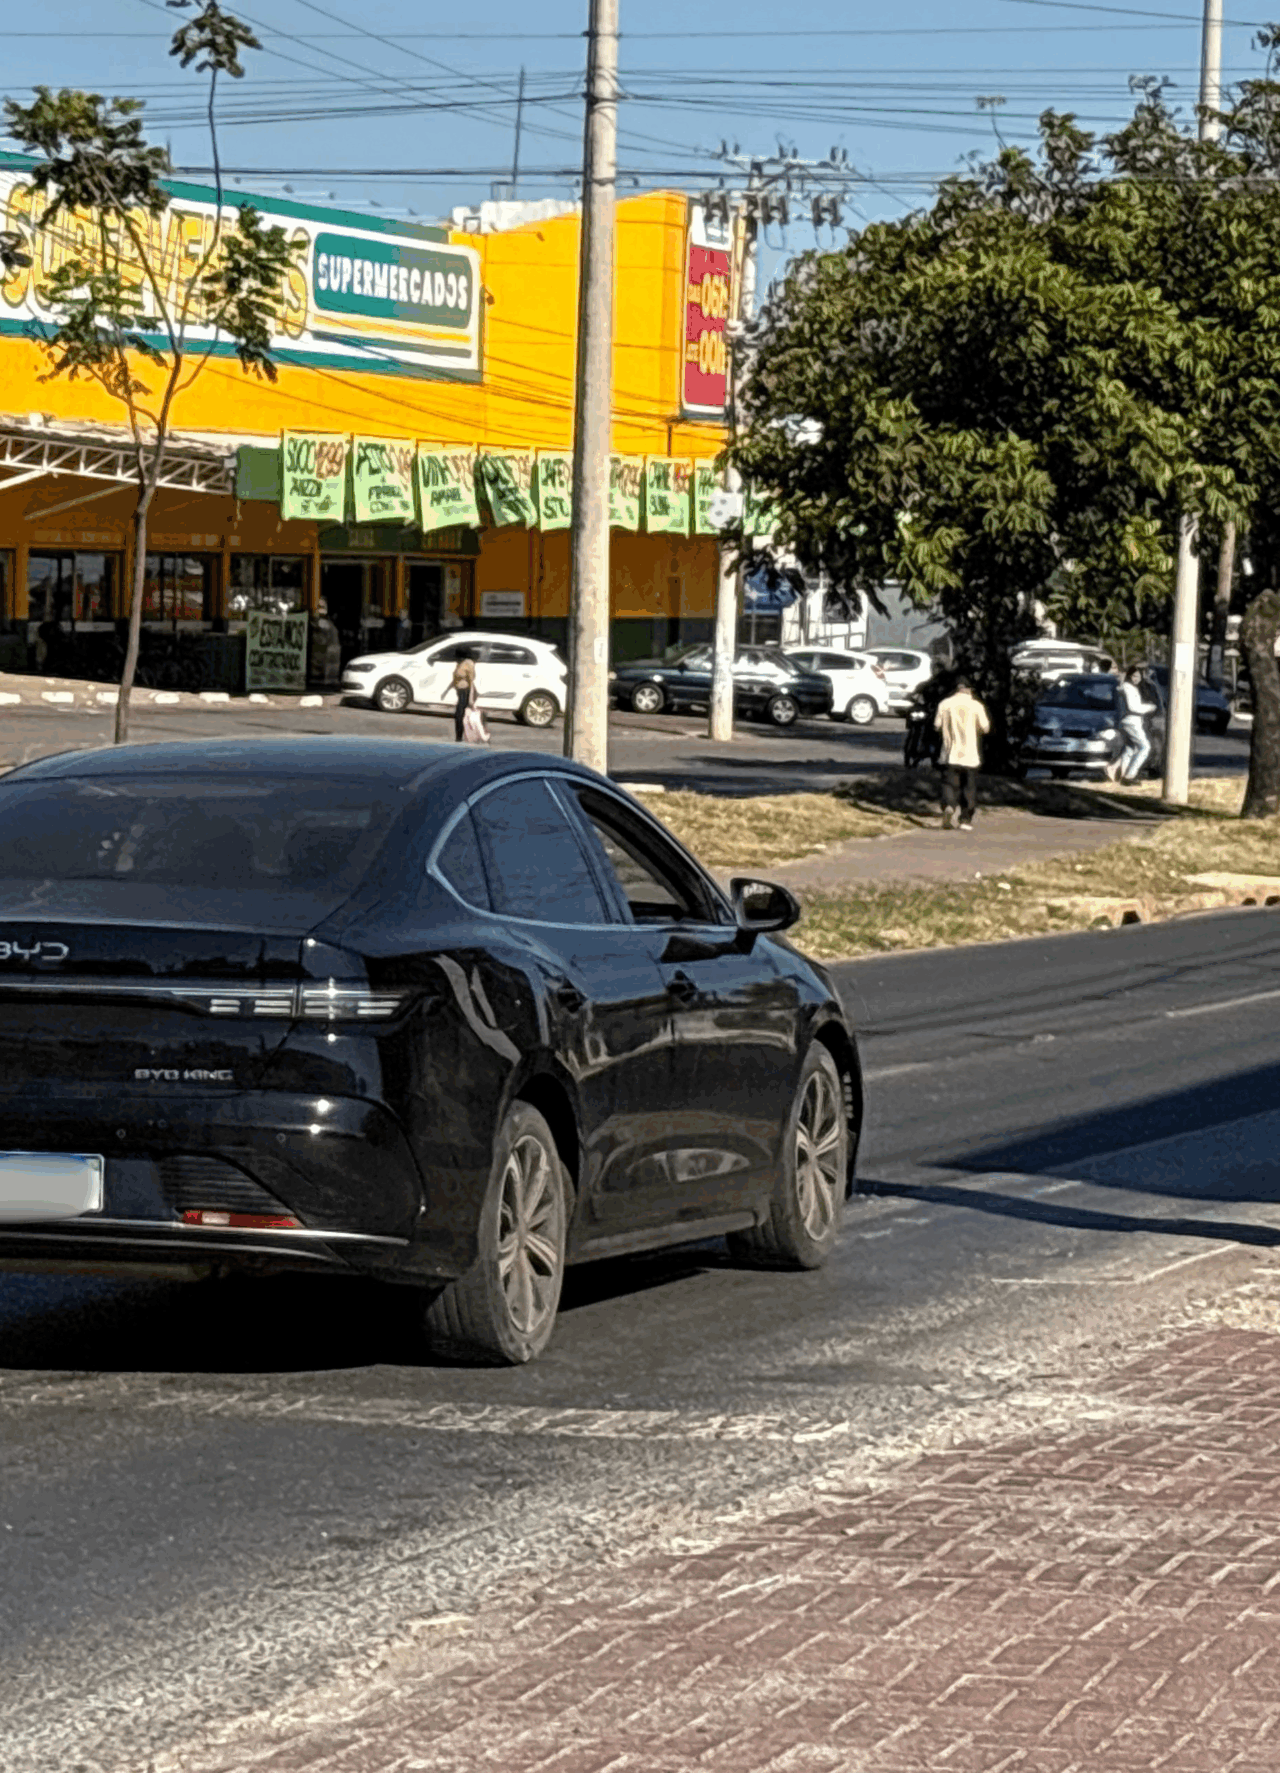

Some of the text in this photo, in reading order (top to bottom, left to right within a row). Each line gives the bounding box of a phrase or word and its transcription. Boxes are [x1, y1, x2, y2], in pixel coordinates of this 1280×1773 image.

[318, 252, 469, 311] SUPERMERCADOS
[135, 1068, 233, 1081] BYD KING
